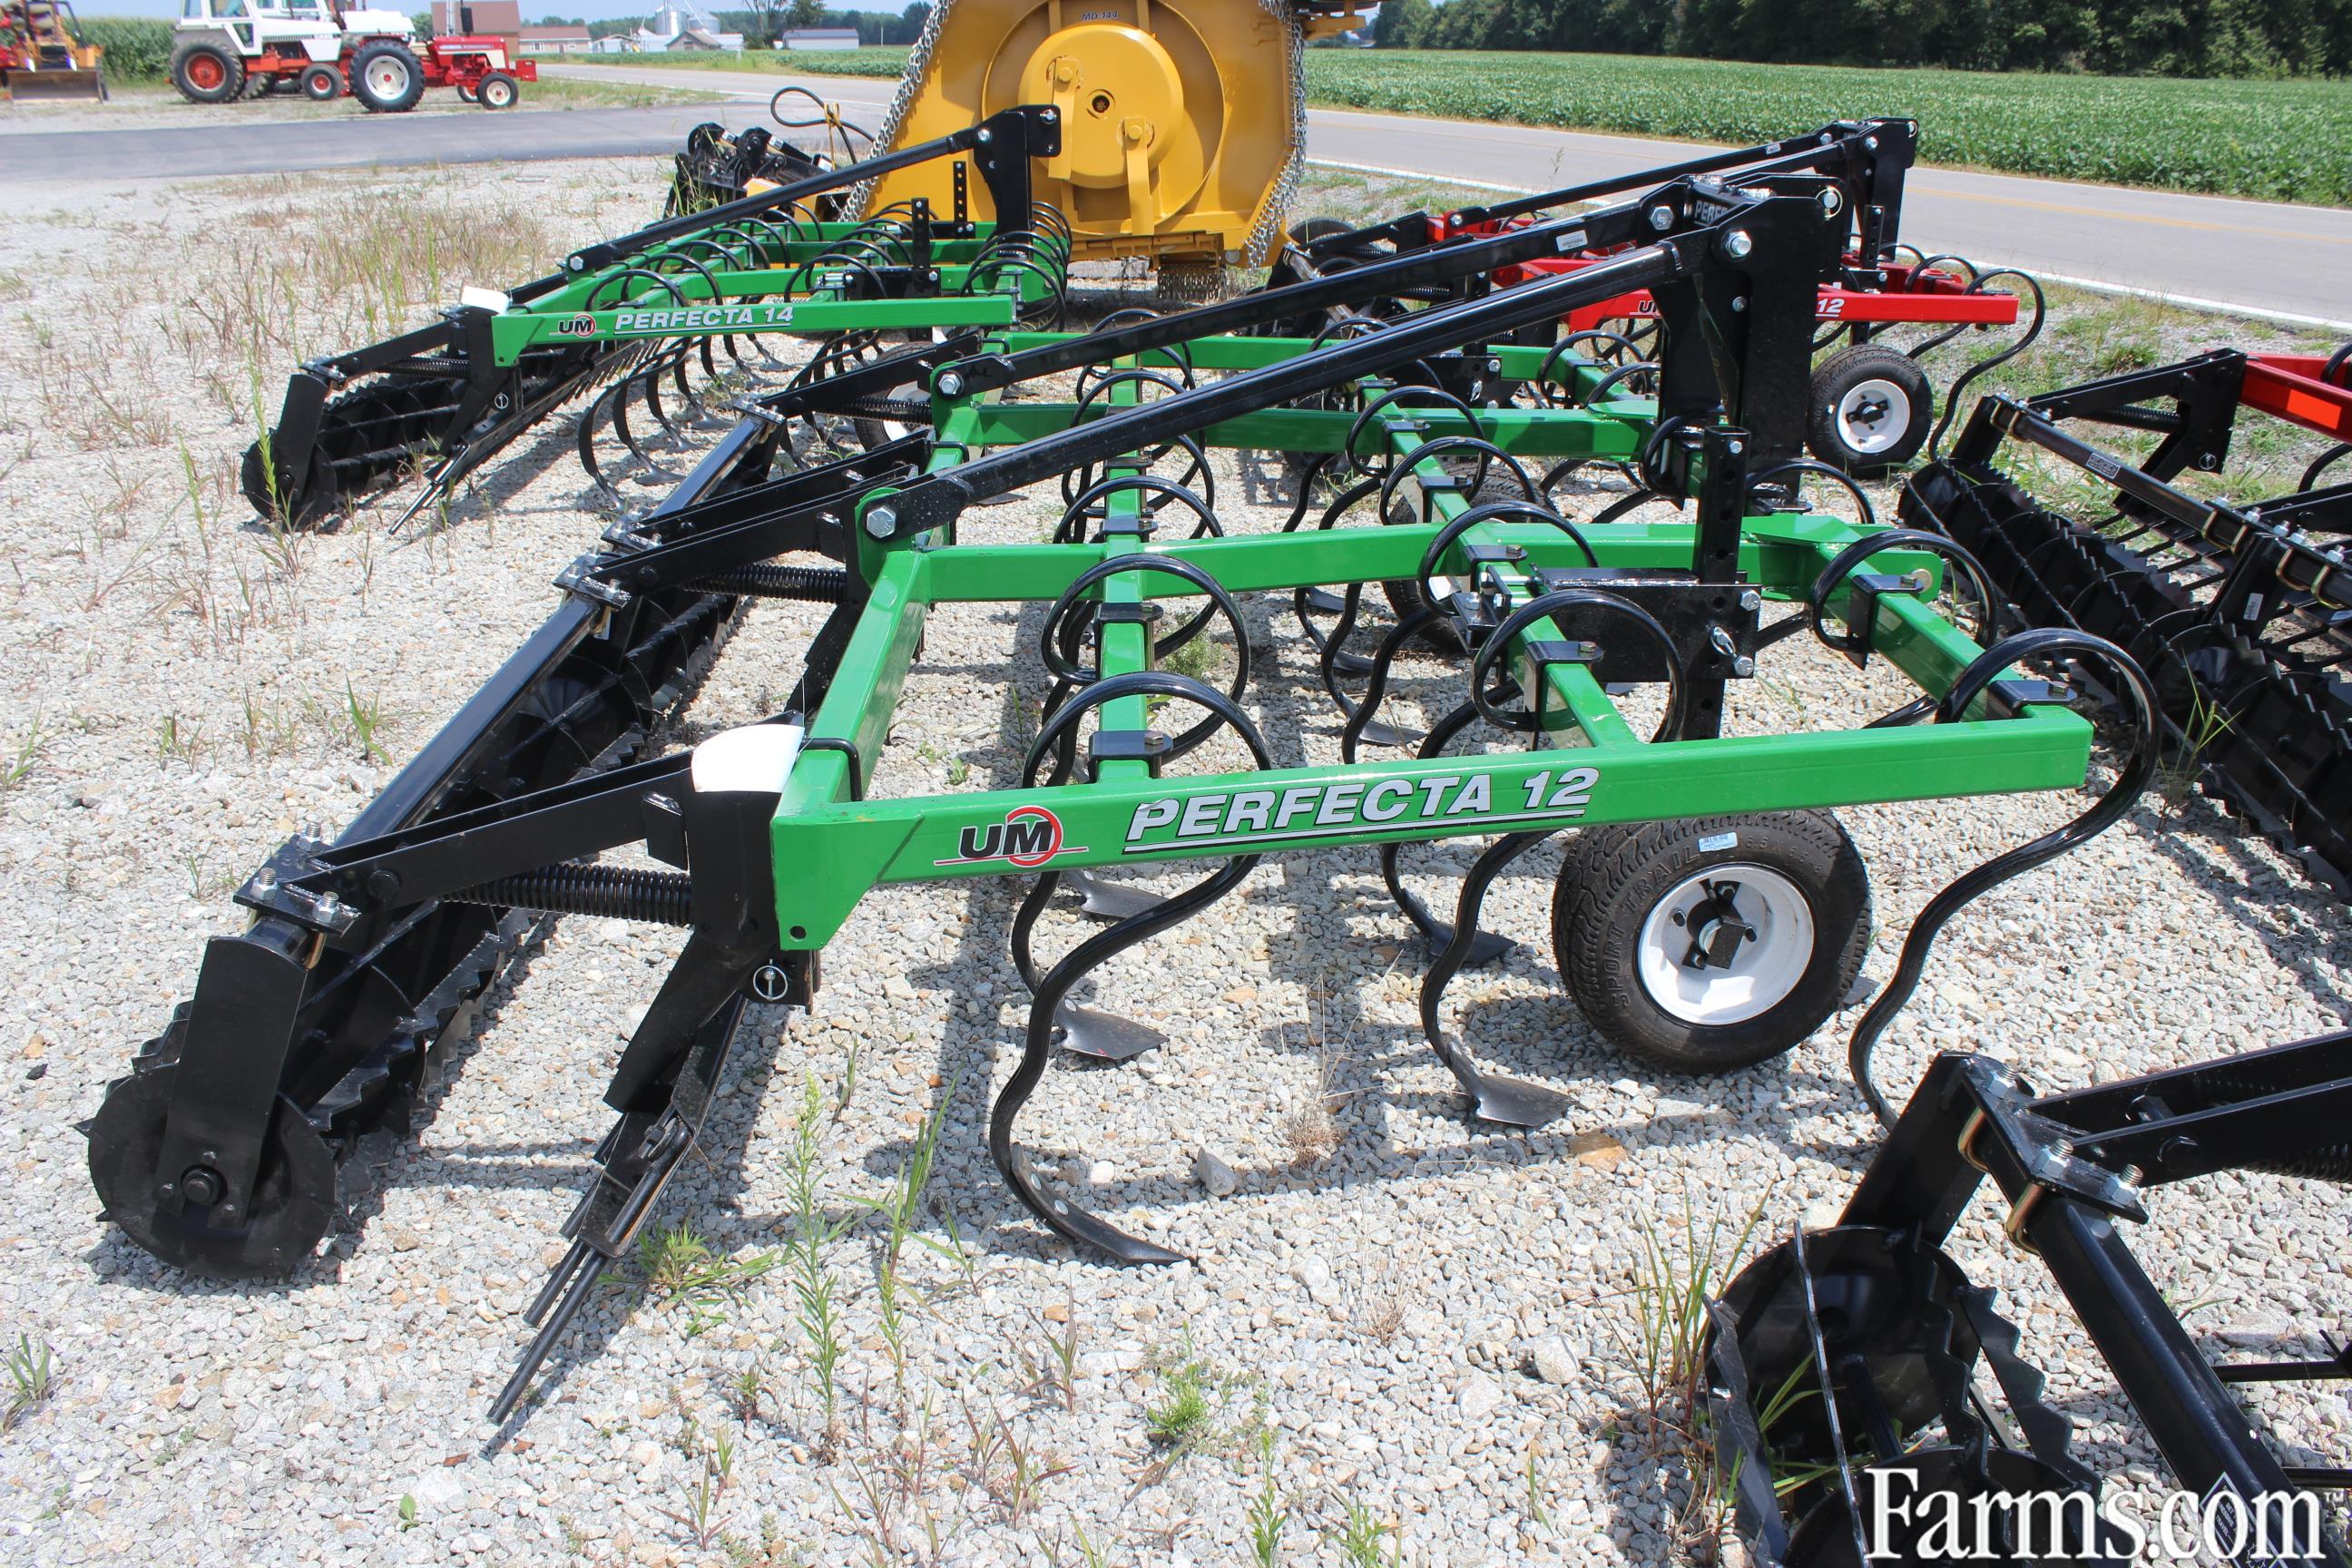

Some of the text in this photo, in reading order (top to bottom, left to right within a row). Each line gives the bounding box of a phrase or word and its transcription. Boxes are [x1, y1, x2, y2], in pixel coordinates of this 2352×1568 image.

[1638, 299, 1659, 315] U
[1818, 297, 1846, 314] 12
[558, 307, 794, 335] UM PERFECTA 14
[958, 766, 1602, 859] UM PERFECTA 12
[1604, 845, 1700, 1007] SPORT TRAIL
